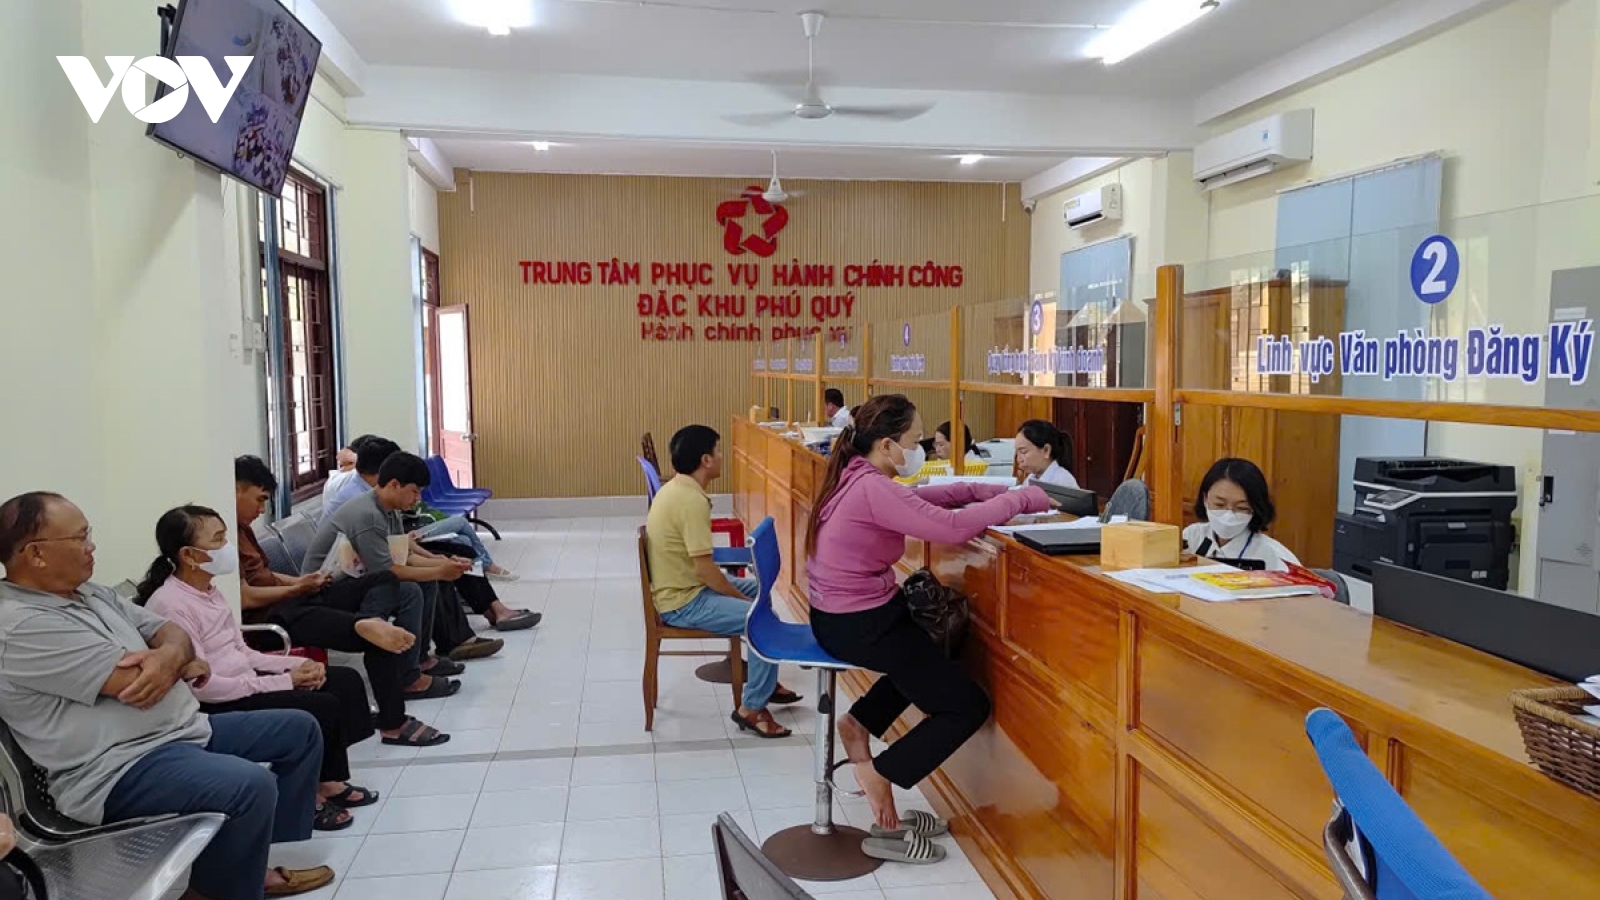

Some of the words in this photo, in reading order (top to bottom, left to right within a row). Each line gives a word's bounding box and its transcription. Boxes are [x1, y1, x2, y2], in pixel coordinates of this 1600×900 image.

[519, 261, 592, 285] TRUNG
[597, 257, 640, 286] TÂM
[651, 262, 713, 290] PHỤC
[727, 263, 758, 290] VỤ
[772, 258, 834, 287] HÀNH
[843, 259, 904, 287] CHÍNH
[908, 261, 964, 287] CÔNG
[1420, 241, 1448, 295] 2
[637, 290, 686, 319] ĐẶC
[697, 294, 745, 318] KHU
[755, 290, 801, 318] PHÚ
[811, 291, 855, 322] QUÝ
[704, 322, 761, 341] chính
[1257, 335, 1292, 375] Lĩnh
[1299, 334, 1334, 382] vực
[1340, 330, 1378, 376] Văn
[1384, 329, 1459, 381] phòng
[1466, 325, 1540, 384] Đăng
[1549, 319, 1593, 385] Ký
